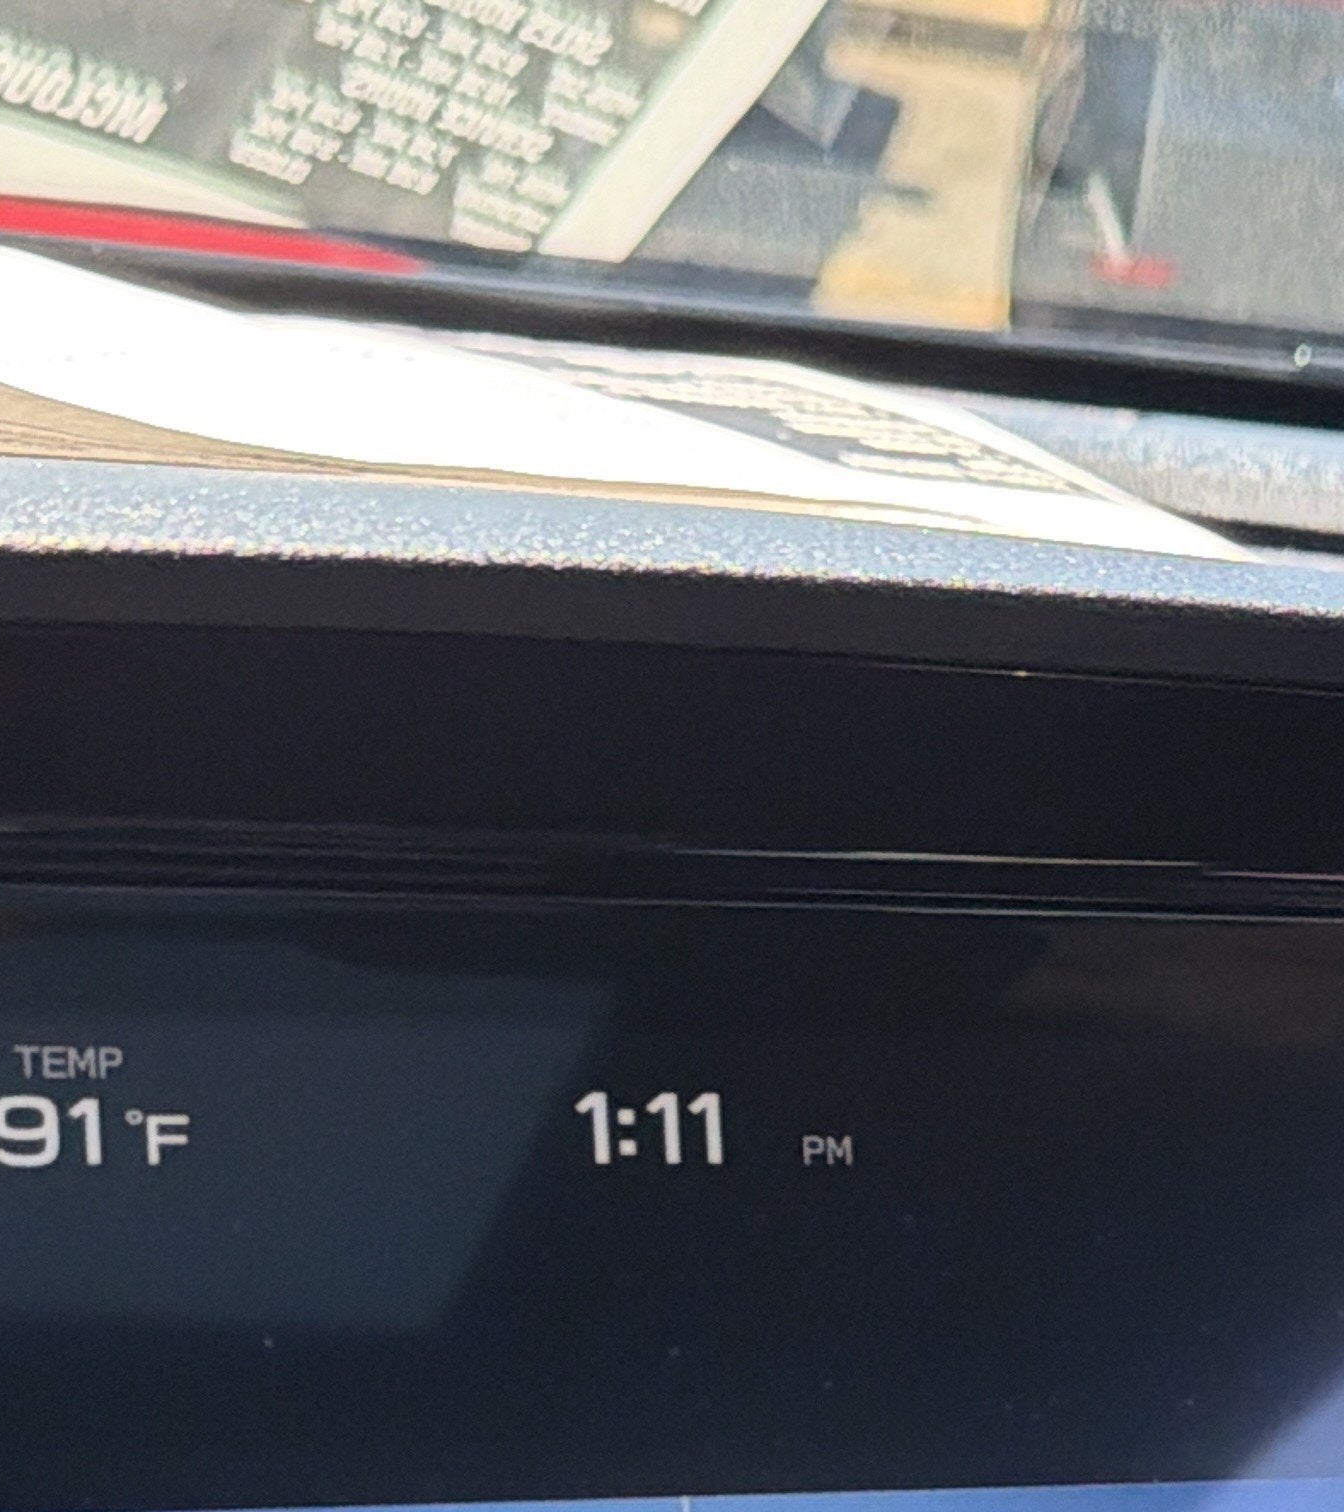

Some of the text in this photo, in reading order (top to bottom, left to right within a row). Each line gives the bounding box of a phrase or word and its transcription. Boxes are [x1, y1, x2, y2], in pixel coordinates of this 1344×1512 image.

[14, 1043, 123, 1079] TEMP
[575, 1091, 723, 1165] 1:11
[802, 1135, 853, 1166] PM
